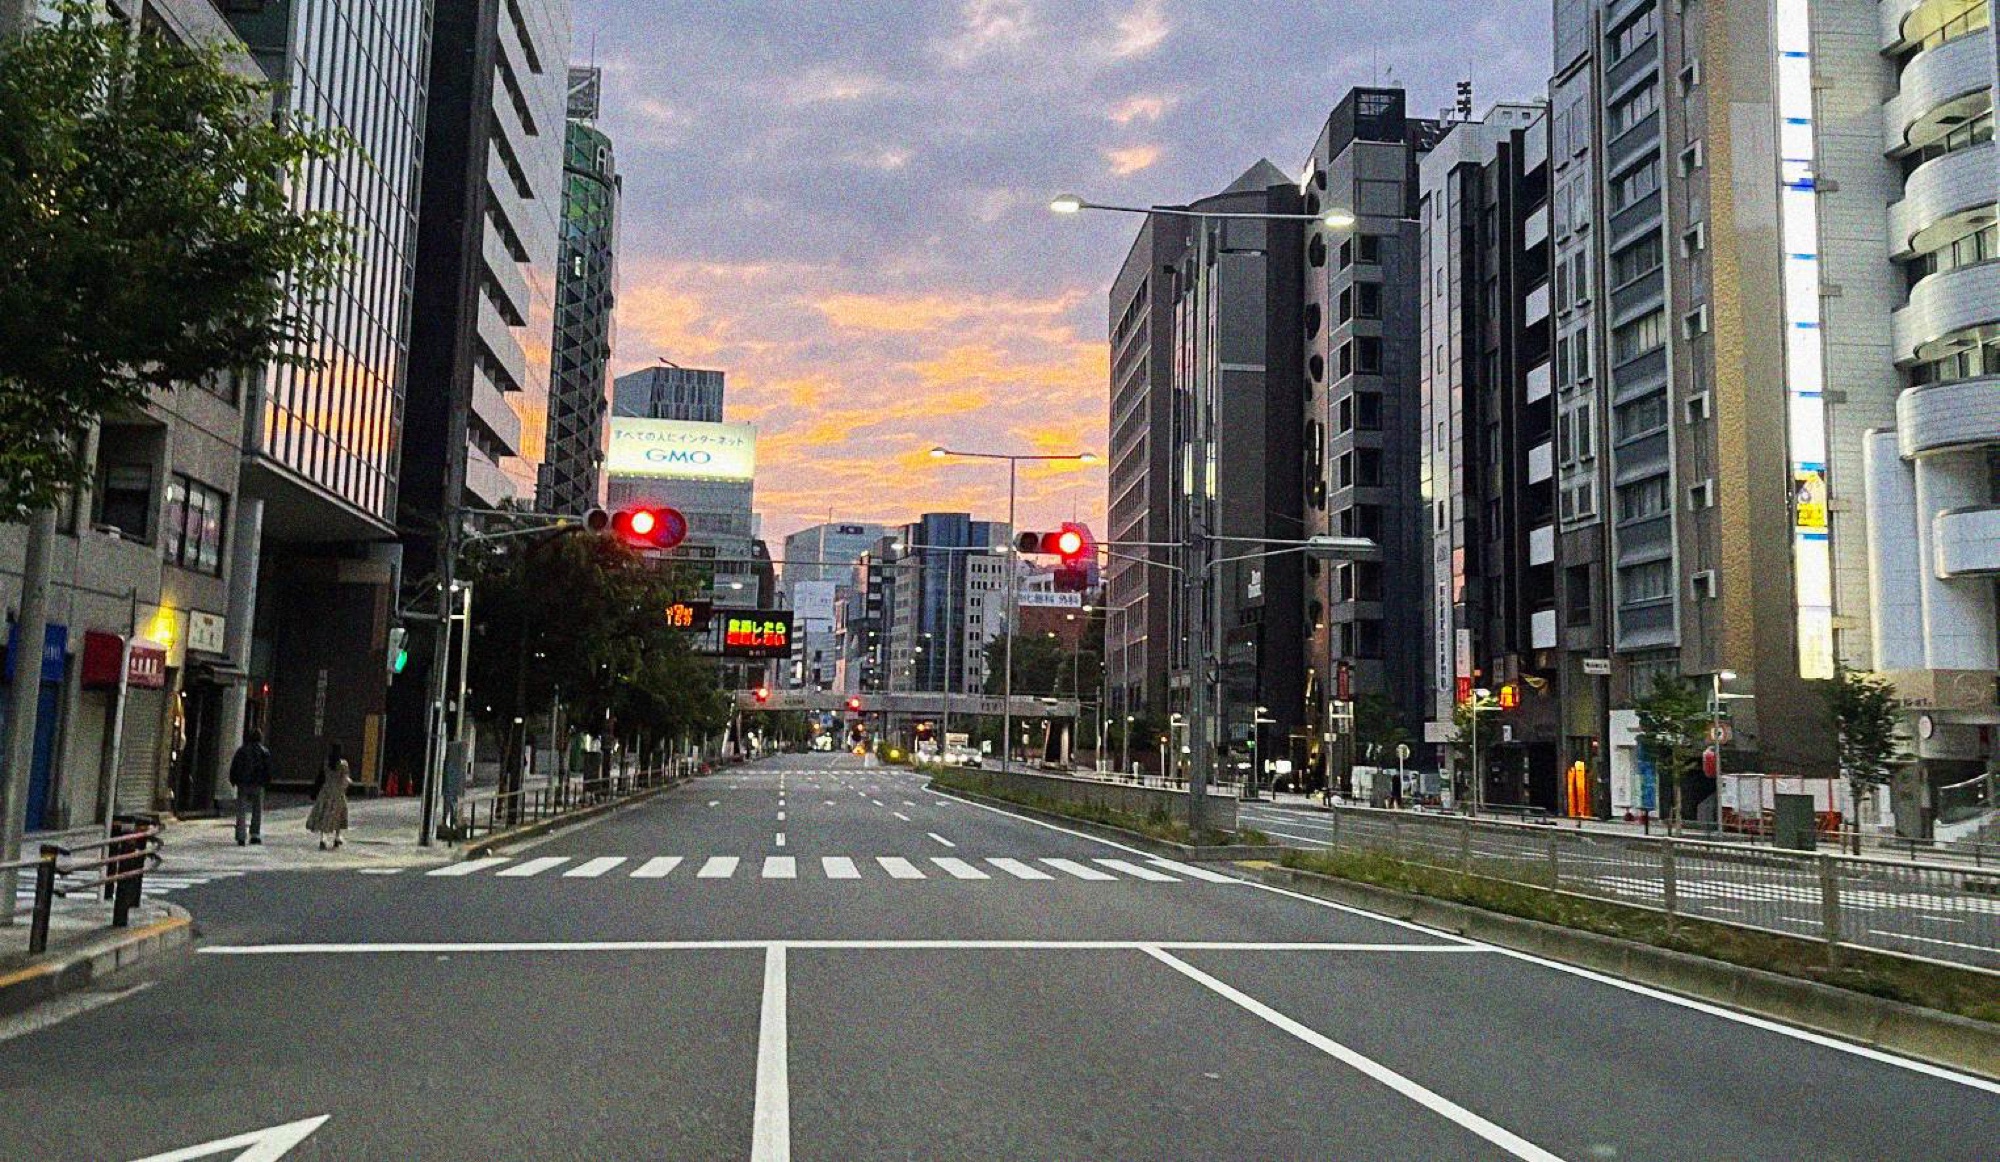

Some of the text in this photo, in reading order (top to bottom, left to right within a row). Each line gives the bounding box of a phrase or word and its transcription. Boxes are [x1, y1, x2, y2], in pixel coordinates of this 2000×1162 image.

[614, 429, 744, 446] すべての人にインターネット
[645, 448, 711, 464] GMO
[728, 618, 787, 634] したら
